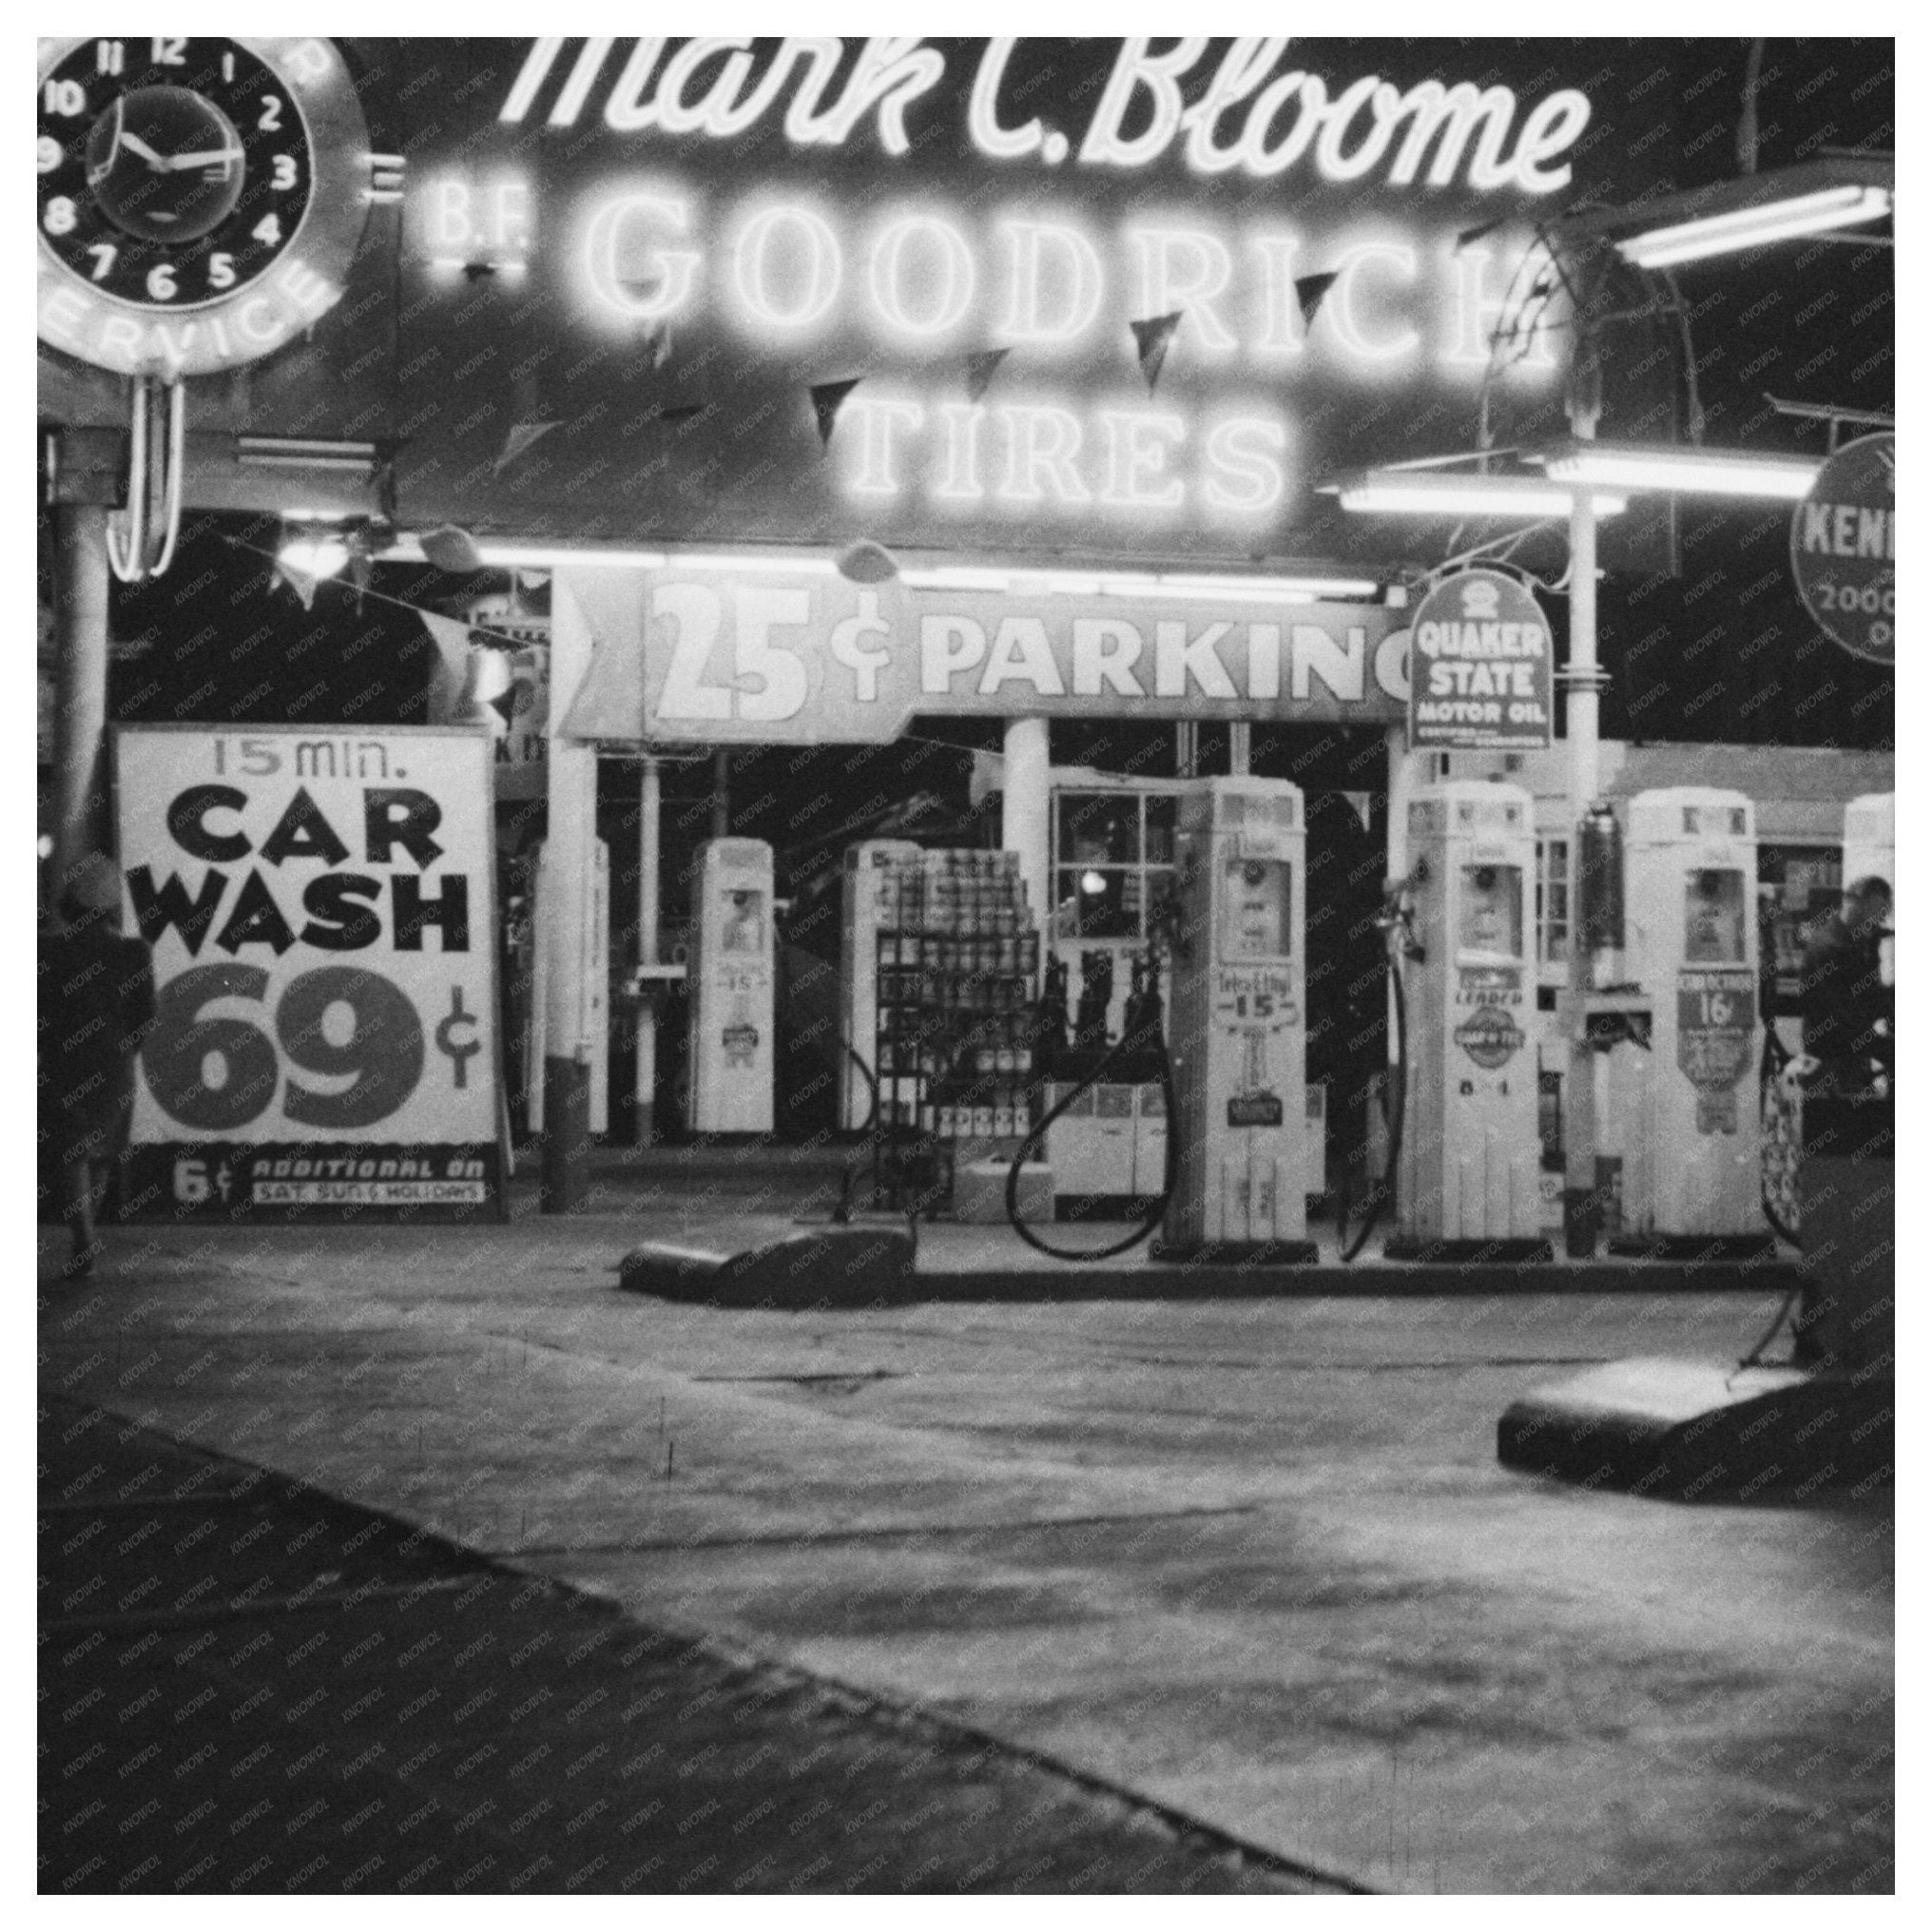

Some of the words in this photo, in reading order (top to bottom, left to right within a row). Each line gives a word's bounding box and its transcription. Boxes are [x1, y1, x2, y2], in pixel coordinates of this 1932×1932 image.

[97, 40, 125, 75] 11
[151, 37, 188, 65] 12
[222, 51, 235, 84] 1
[44, 79, 87, 117] 10
[258, 95, 282, 131] 2
[497, 37, 946, 157] Mark
[37, 136, 64, 173] 9
[270, 153, 297, 190] 3
[43, 196, 77, 235] 8
[251, 212, 282, 247] 4
[88, 243, 118, 280] 7
[207, 252, 237, 288] 5
[436, 180, 530, 249] B.F.
[582, 192, 1557, 371] GOODRICH
[146, 264, 178, 299] 6
[37, 258, 330, 362] ERVICE
[835, 396, 1287, 512] TIRES
[1805, 502, 1895, 560] KEN
[1418, 621, 1544, 658] QUAKER
[1429, 662, 1535, 697] STATE
[1417, 702, 1501, 723] MOTOR
[1508, 702, 1548, 724] OIL
[214, 740, 280, 776] 15
[166, 783, 445, 870] CAR
[126, 863, 470, 956] WASH
[252, 1159, 433, 1178] ADDITIONAL
